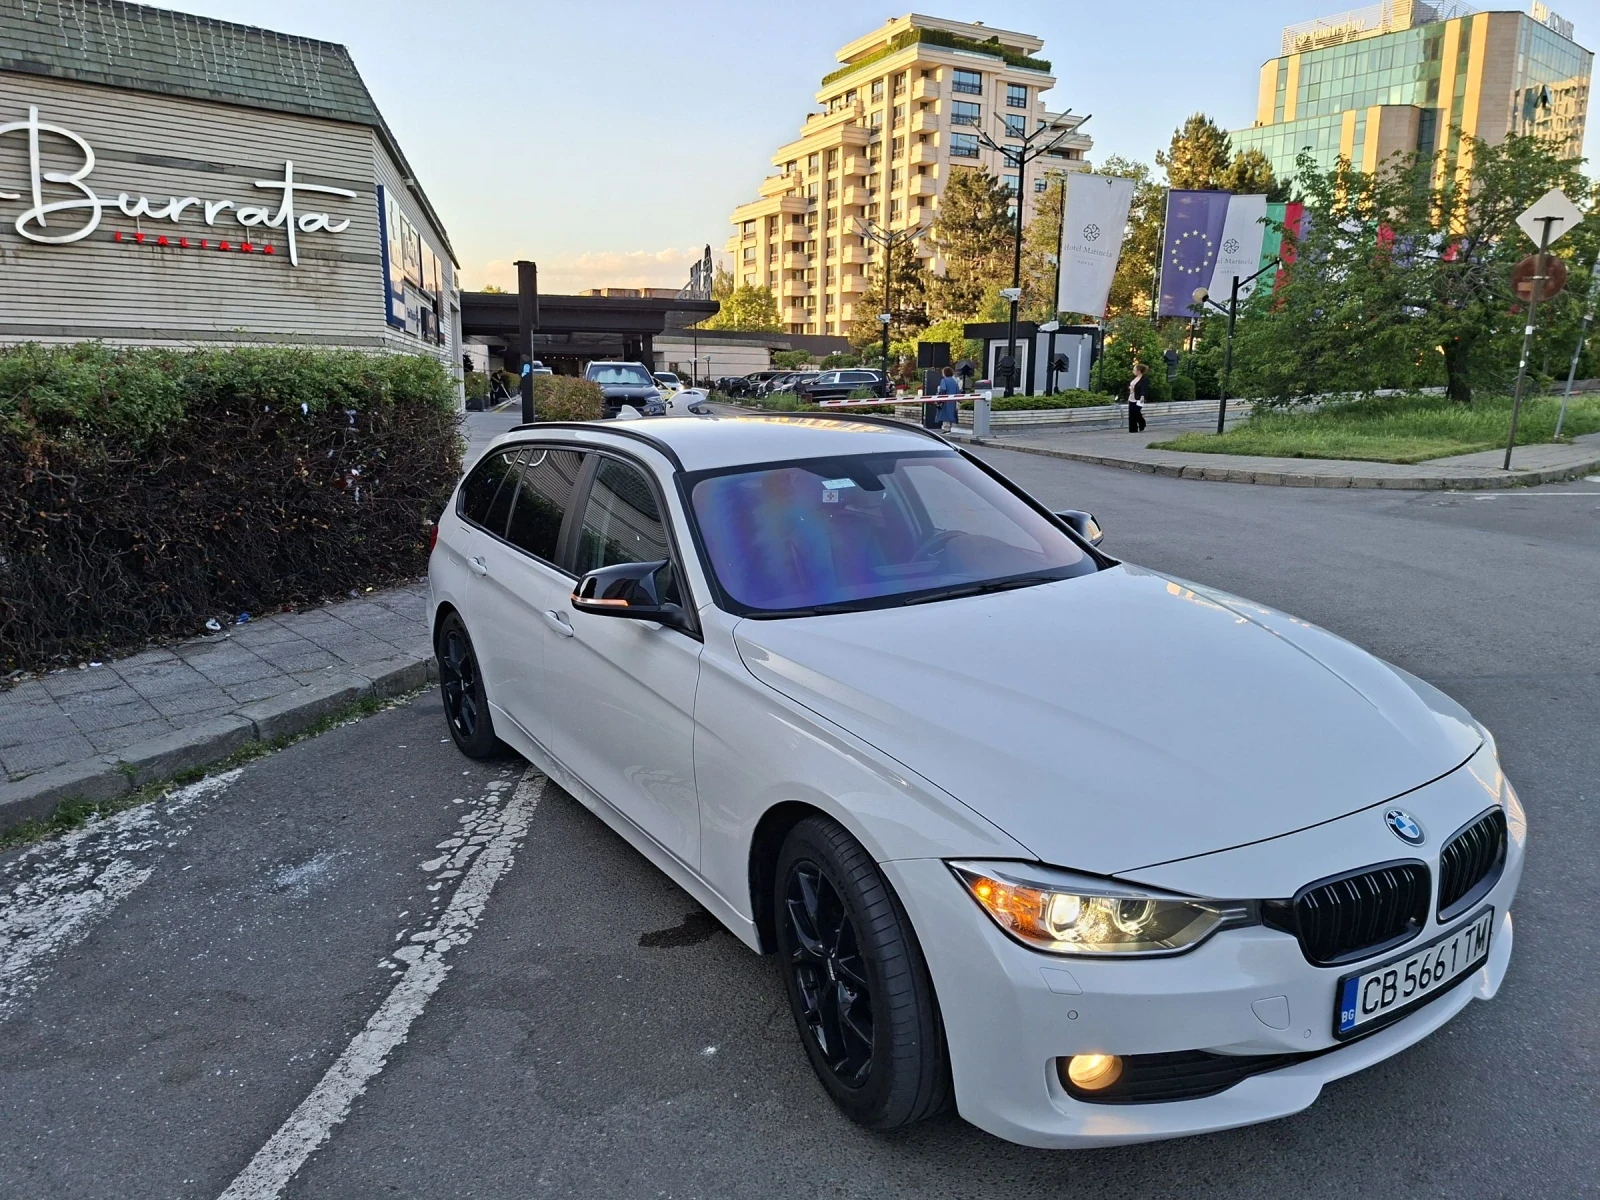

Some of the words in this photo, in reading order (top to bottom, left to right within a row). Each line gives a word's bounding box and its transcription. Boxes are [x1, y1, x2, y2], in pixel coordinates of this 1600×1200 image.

[0, 105, 357, 266] Burrata
[115, 231, 275, 254] ITALIANA
[1064, 244, 1081, 252] Hotel
[1083, 246, 1112, 258] Marinela
[1362, 969, 1398, 1015] CB
[1403, 937, 1459, 998] 5661
[1465, 917, 1488, 963] TM
[1341, 1009, 1355, 1023] BG
